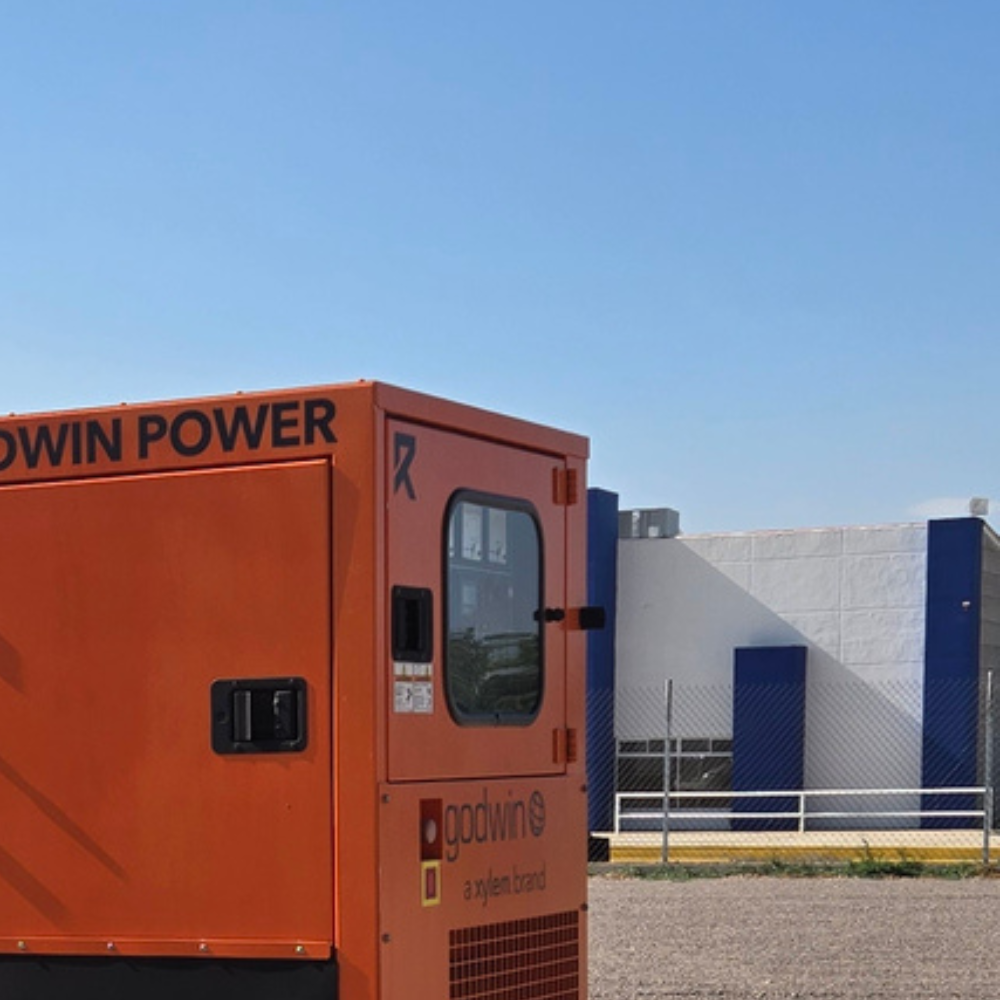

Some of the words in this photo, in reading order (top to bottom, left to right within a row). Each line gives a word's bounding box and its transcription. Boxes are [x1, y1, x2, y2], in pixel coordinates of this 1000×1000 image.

[138, 399, 338, 460] POWER
[445, 787, 526, 862] godwin
[464, 880, 472, 900] a
[475, 868, 511, 907] xylem
[513, 862, 546, 894] brand
